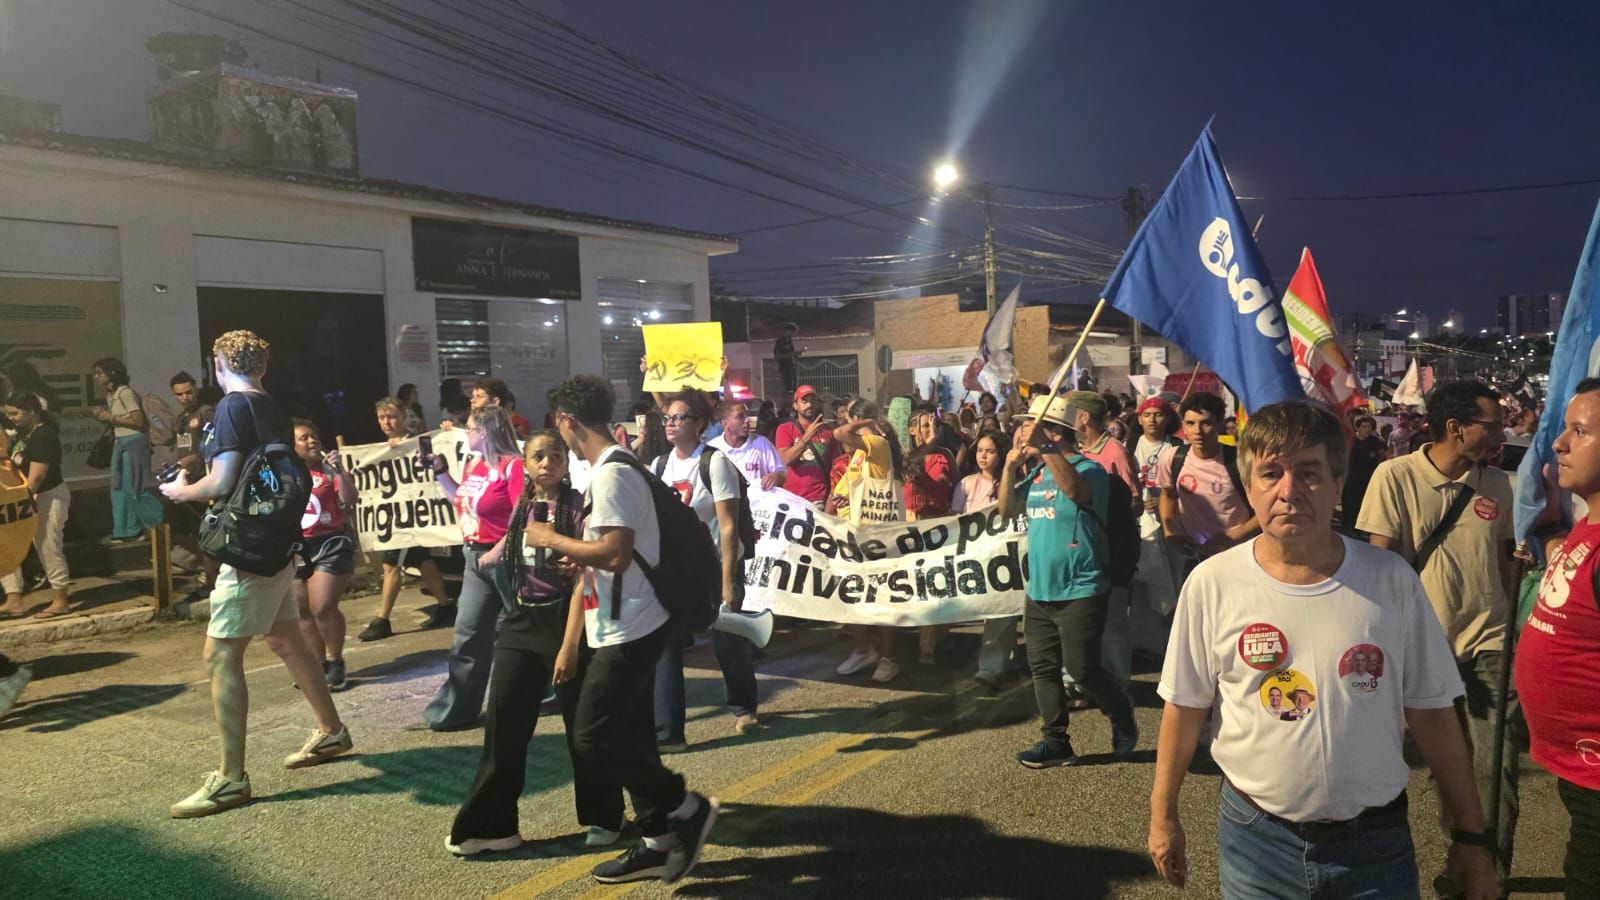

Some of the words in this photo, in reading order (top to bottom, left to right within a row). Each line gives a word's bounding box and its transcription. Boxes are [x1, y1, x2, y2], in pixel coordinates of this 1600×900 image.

[868, 488, 893, 499] NÃO
[860, 499, 900, 510] APERTE
[357, 490, 457, 543] inguém
[860, 511, 898, 522] MINHA
[895, 524, 949, 555] do
[1243, 640, 1284, 657] LULA
